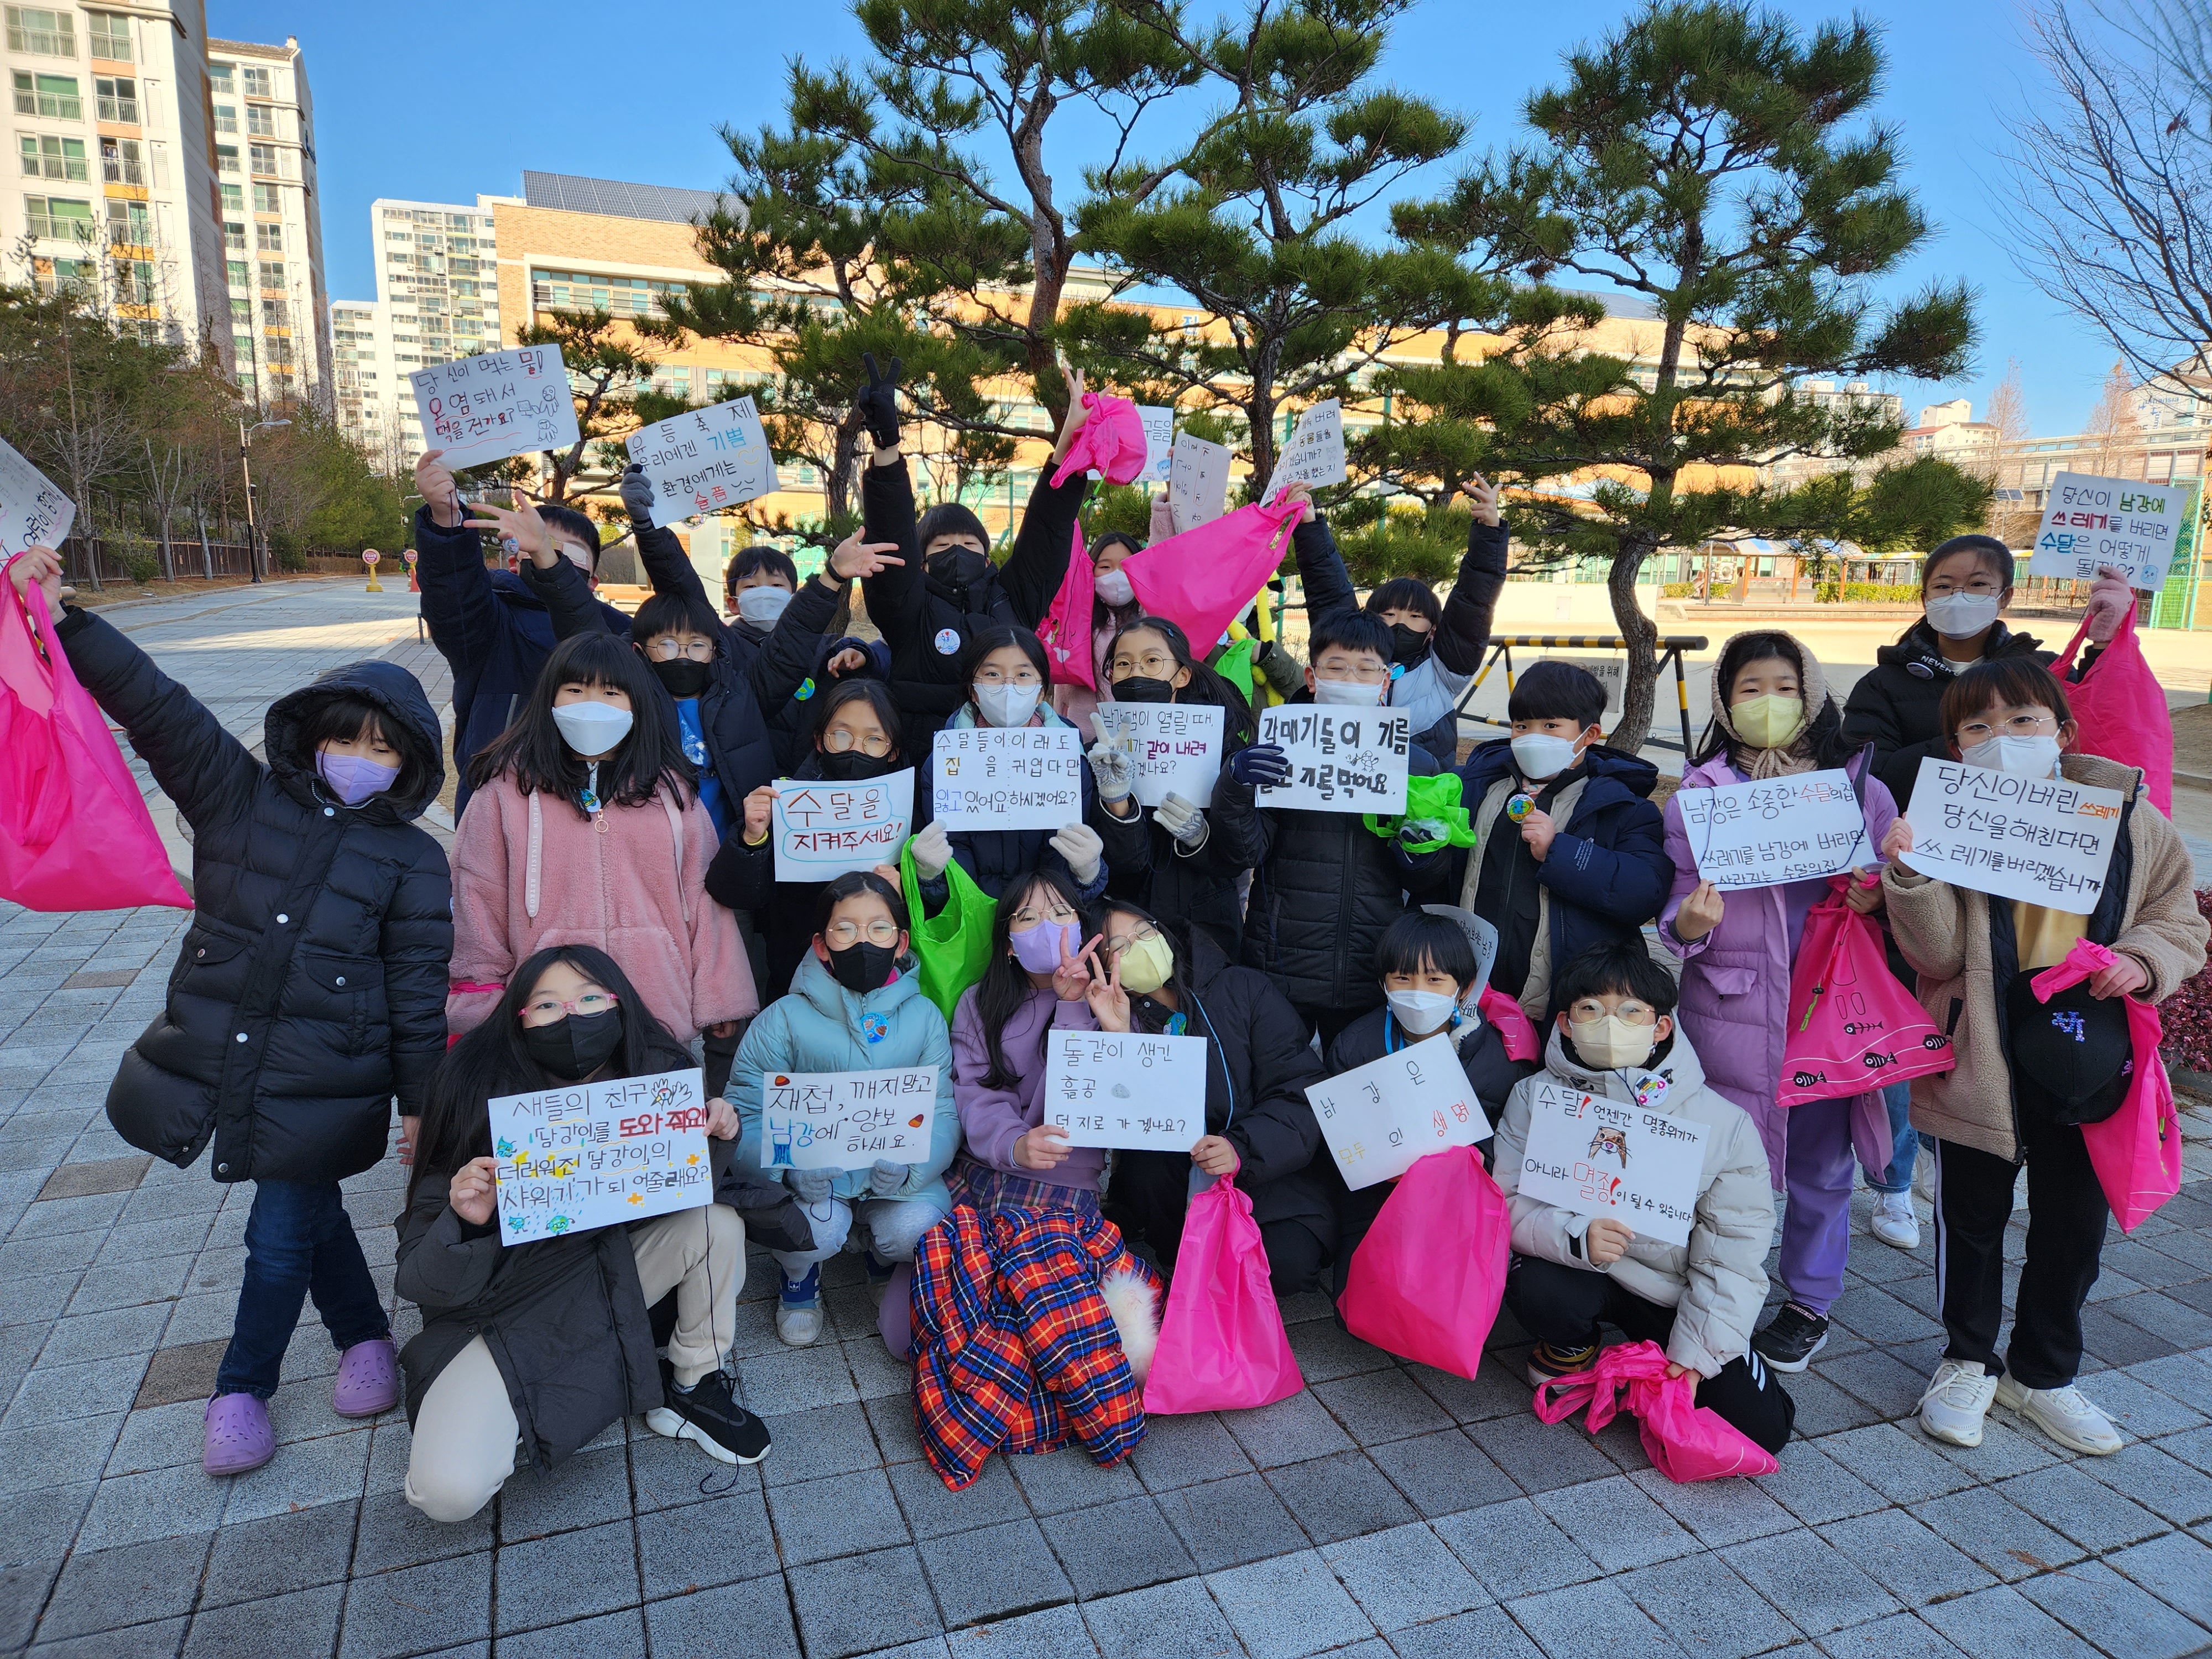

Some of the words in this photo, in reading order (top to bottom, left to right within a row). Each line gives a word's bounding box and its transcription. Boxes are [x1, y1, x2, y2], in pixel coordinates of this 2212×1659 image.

[478, 357, 513, 375] 먹는
[519, 351, 542, 375] 물!
[1315, 409, 1335, 423] 버려
[435, 420, 463, 443] 먹을
[639, 440, 698, 472] 우리에겐
[707, 426, 747, 451] 기쁨
[661, 460, 737, 497] 환경에게는
[695, 486, 727, 510] 슬픔
[2062, 486, 2111, 507] 당신이
[2119, 492, 2166, 514] 남강에
[2130, 519, 2169, 541] 버리면
[2040, 532, 2092, 555] 수달은
[2100, 539, 2151, 565] 어떻게
[1157, 711, 1189, 735] 열릴
[1378, 717, 1410, 755] 기름
[1147, 739, 1170, 760] 같이
[1176, 740, 1207, 757] 내려
[1011, 758, 1080, 778] 귀엽다만
[787, 789, 880, 827] 수달을
[1684, 796, 1741, 824] 남강은
[1747, 784, 1798, 820] 소중한
[1701, 846, 1755, 869] 쓰레기를
[1758, 841, 1808, 862] 남강에
[1817, 829, 1866, 850] 버리면
[1062, 1038, 1123, 1067] 돌같이
[1137, 1041, 1173, 1068] 생긴
[513, 1089, 591, 1121] 새들의
[604, 1083, 648, 1109] 친구
[1594, 1104, 1633, 1128] 언젠간
[619, 1112, 664, 1138] 도와
[770, 1117, 846, 1147] 남강에
[852, 1107, 897, 1133] 양보
[1525, 1158, 1569, 1181] 아니라
[1645, 1199, 1655, 1212] 수
[1659, 1203, 1693, 1223] 있습니다
